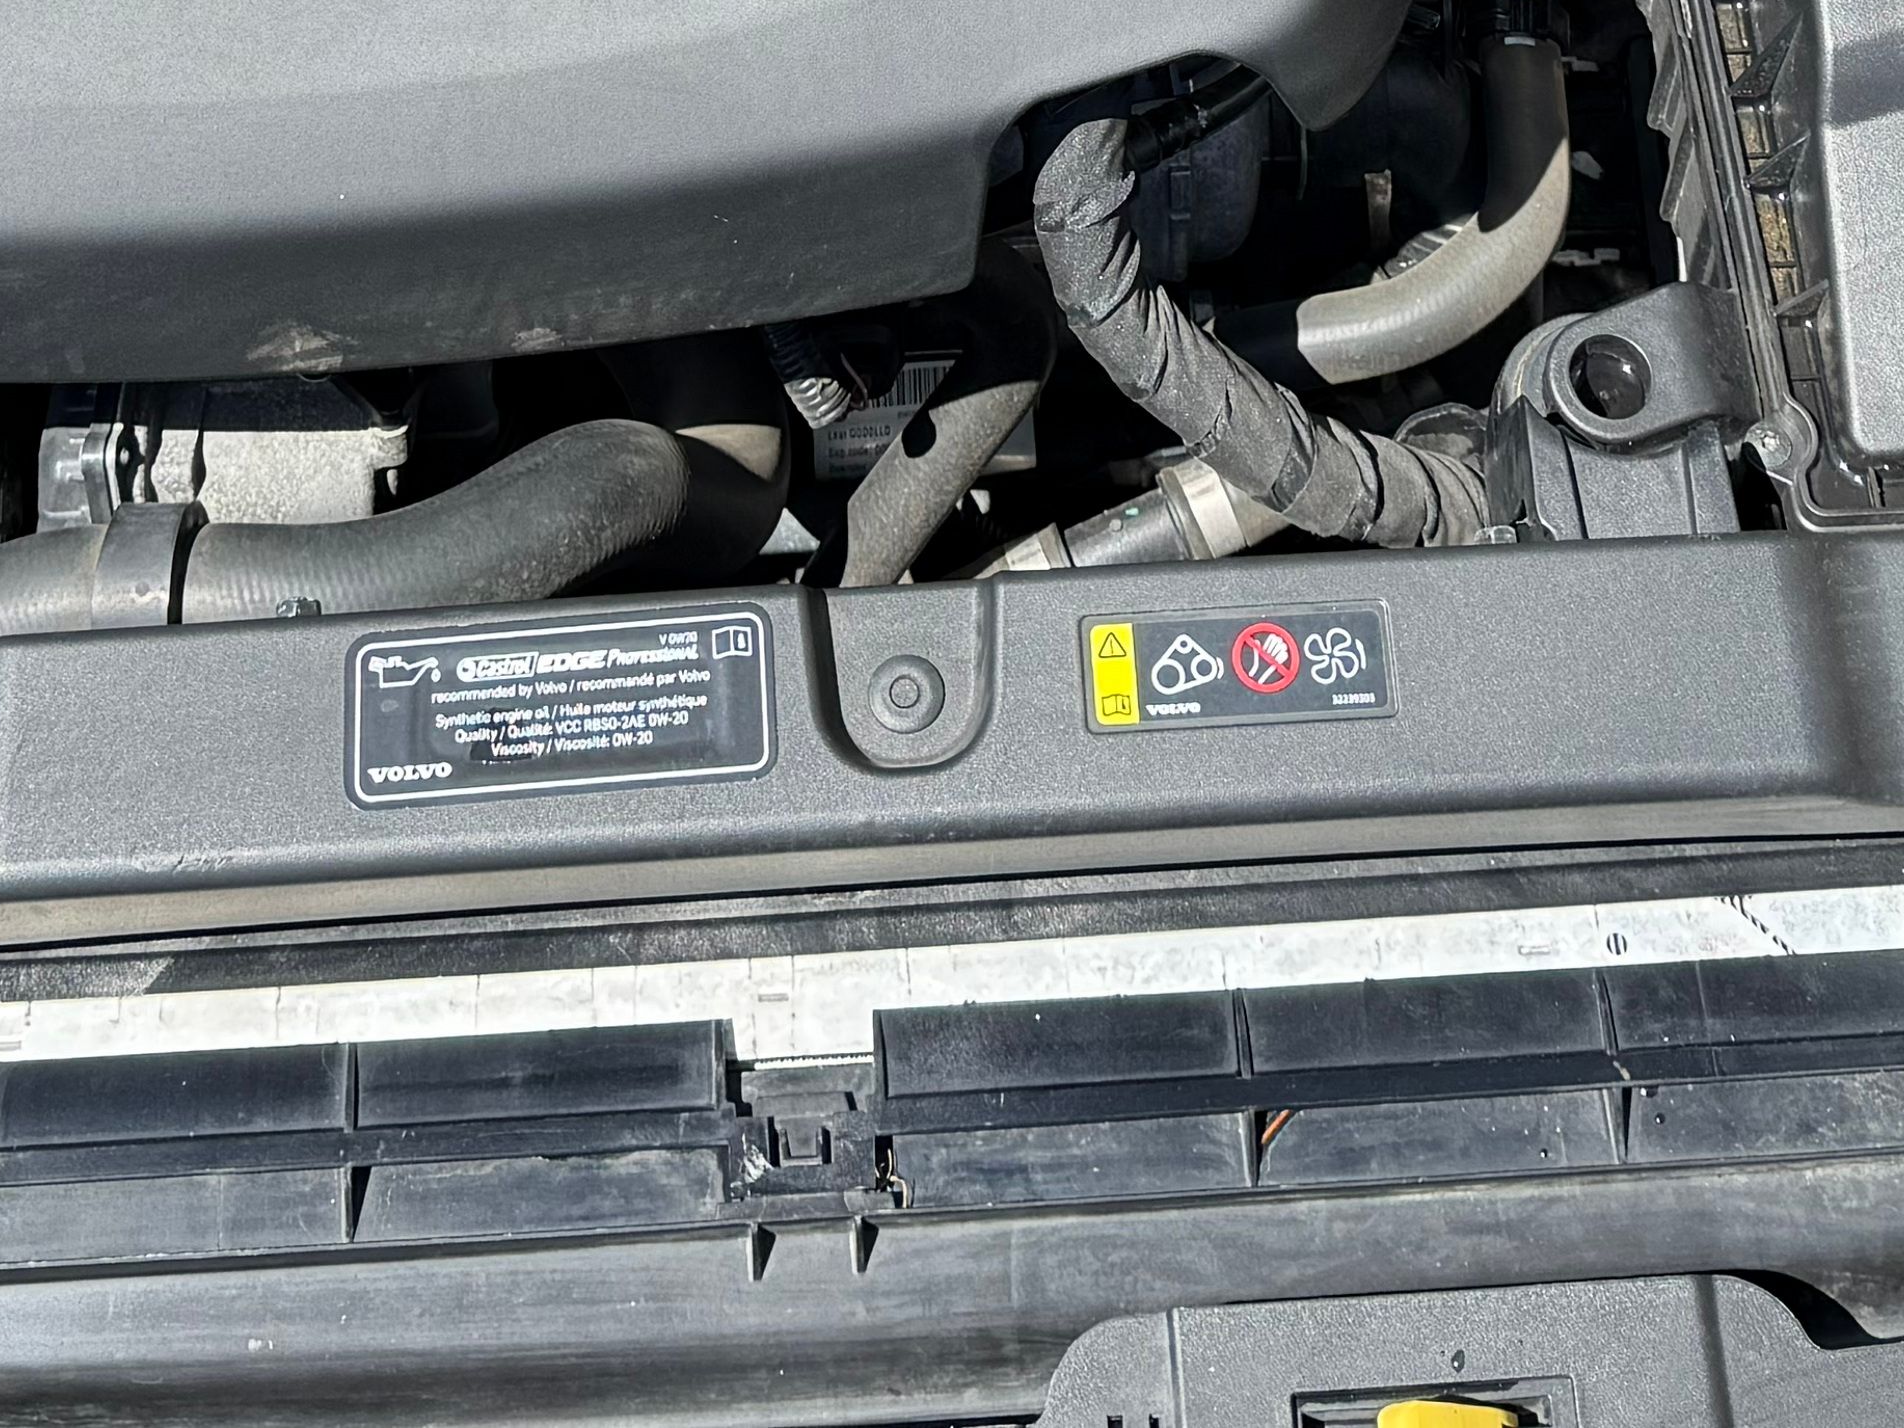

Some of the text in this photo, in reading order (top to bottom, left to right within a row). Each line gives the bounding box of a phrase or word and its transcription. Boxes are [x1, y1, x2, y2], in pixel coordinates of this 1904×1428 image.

[536, 649, 608, 674] EDGE
[431, 684, 516, 704] recommended
[518, 683, 533, 699] by
[535, 681, 567, 696] Volvo
[576, 672, 655, 692] recommandé
[656, 673, 677, 688] par
[678, 669, 711, 683] Volvo
[435, 710, 492, 730] Synthetic
[492, 708, 534, 724] engine
[535, 706, 550, 720] oil
[559, 703, 591, 717] Huile
[593, 700, 636, 715] moteur
[637, 693, 708, 713] synthétique
[1146, 702, 1201, 716] VOLVO
[455, 726, 498, 743] Quality
[555, 719, 582, 735] VCC
[491, 740, 545, 758] Viscosity
[612, 730, 654, 748] 0W-20
[367, 761, 453, 783] VOLVO
